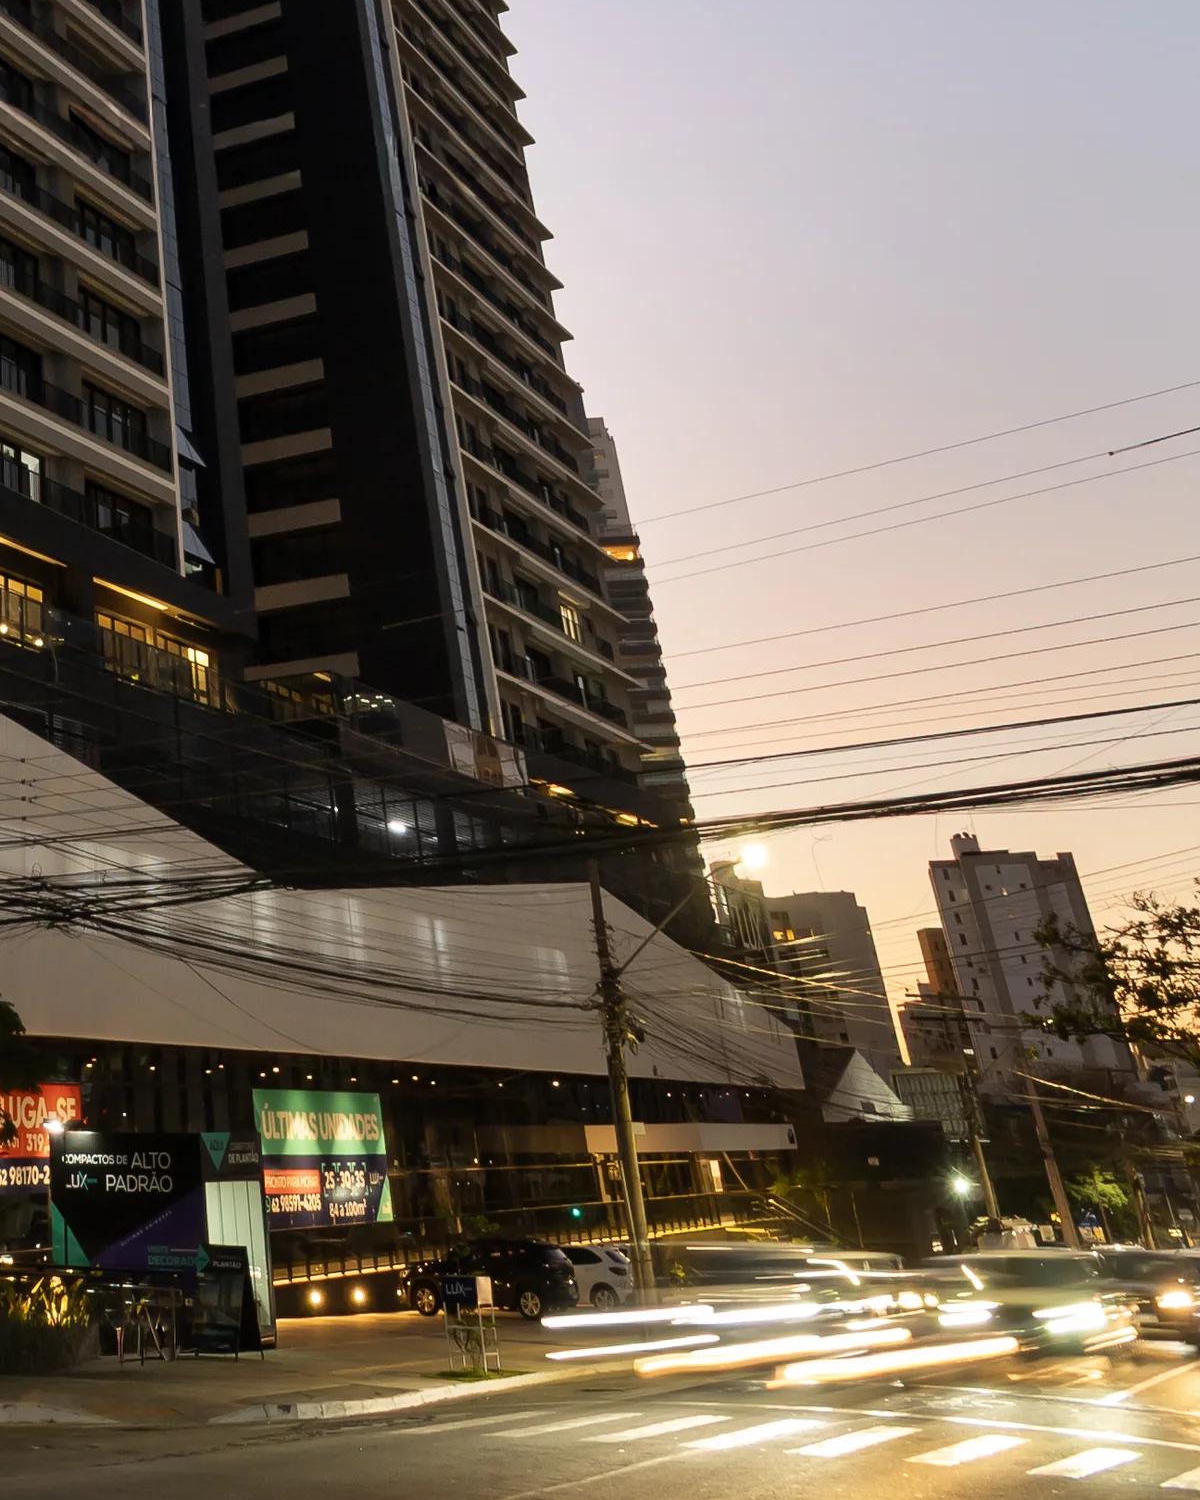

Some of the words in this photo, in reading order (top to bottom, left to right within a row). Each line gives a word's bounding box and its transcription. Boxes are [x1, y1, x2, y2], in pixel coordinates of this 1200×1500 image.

[261, 1102, 319, 1140] ÚLTIMAS
[319, 1112, 380, 1141] UNIDADES
[62, 1154, 115, 1165] COMPACTOS
[116, 1155, 128, 1164] DE
[131, 1152, 171, 1169] ALTO
[105, 1171, 173, 1192] PADRÃO
